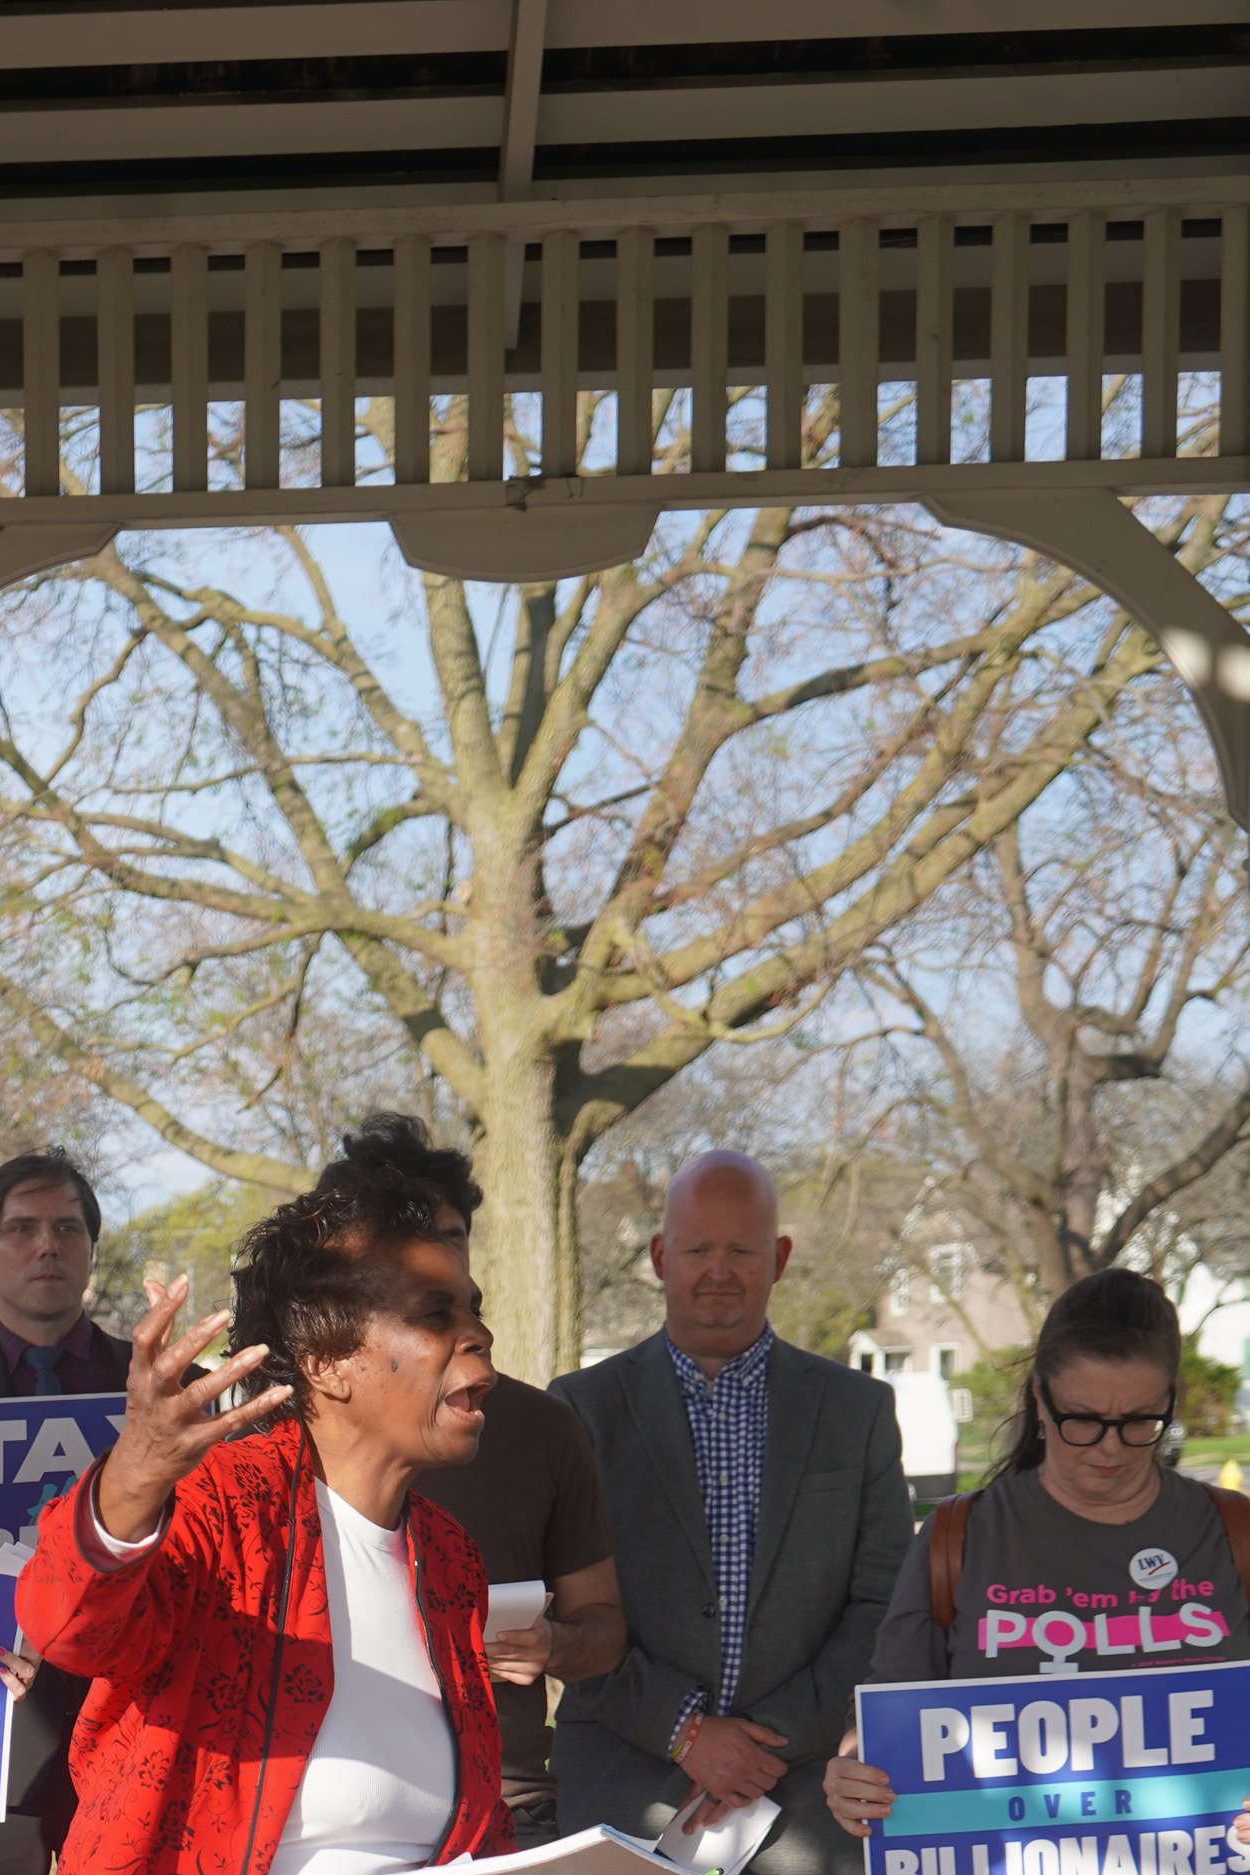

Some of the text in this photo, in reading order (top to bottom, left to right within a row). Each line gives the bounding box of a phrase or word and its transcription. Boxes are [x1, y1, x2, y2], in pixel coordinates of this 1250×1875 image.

[986, 1584, 1057, 1605] Grab
[1065, 1587, 1118, 1608] 'em
[1171, 1578, 1215, 1600] the
[985, 1602, 1223, 1672] POLLS
[919, 1689, 1216, 1781] PEOPLE
[1008, 1789, 1133, 1821] OVER
